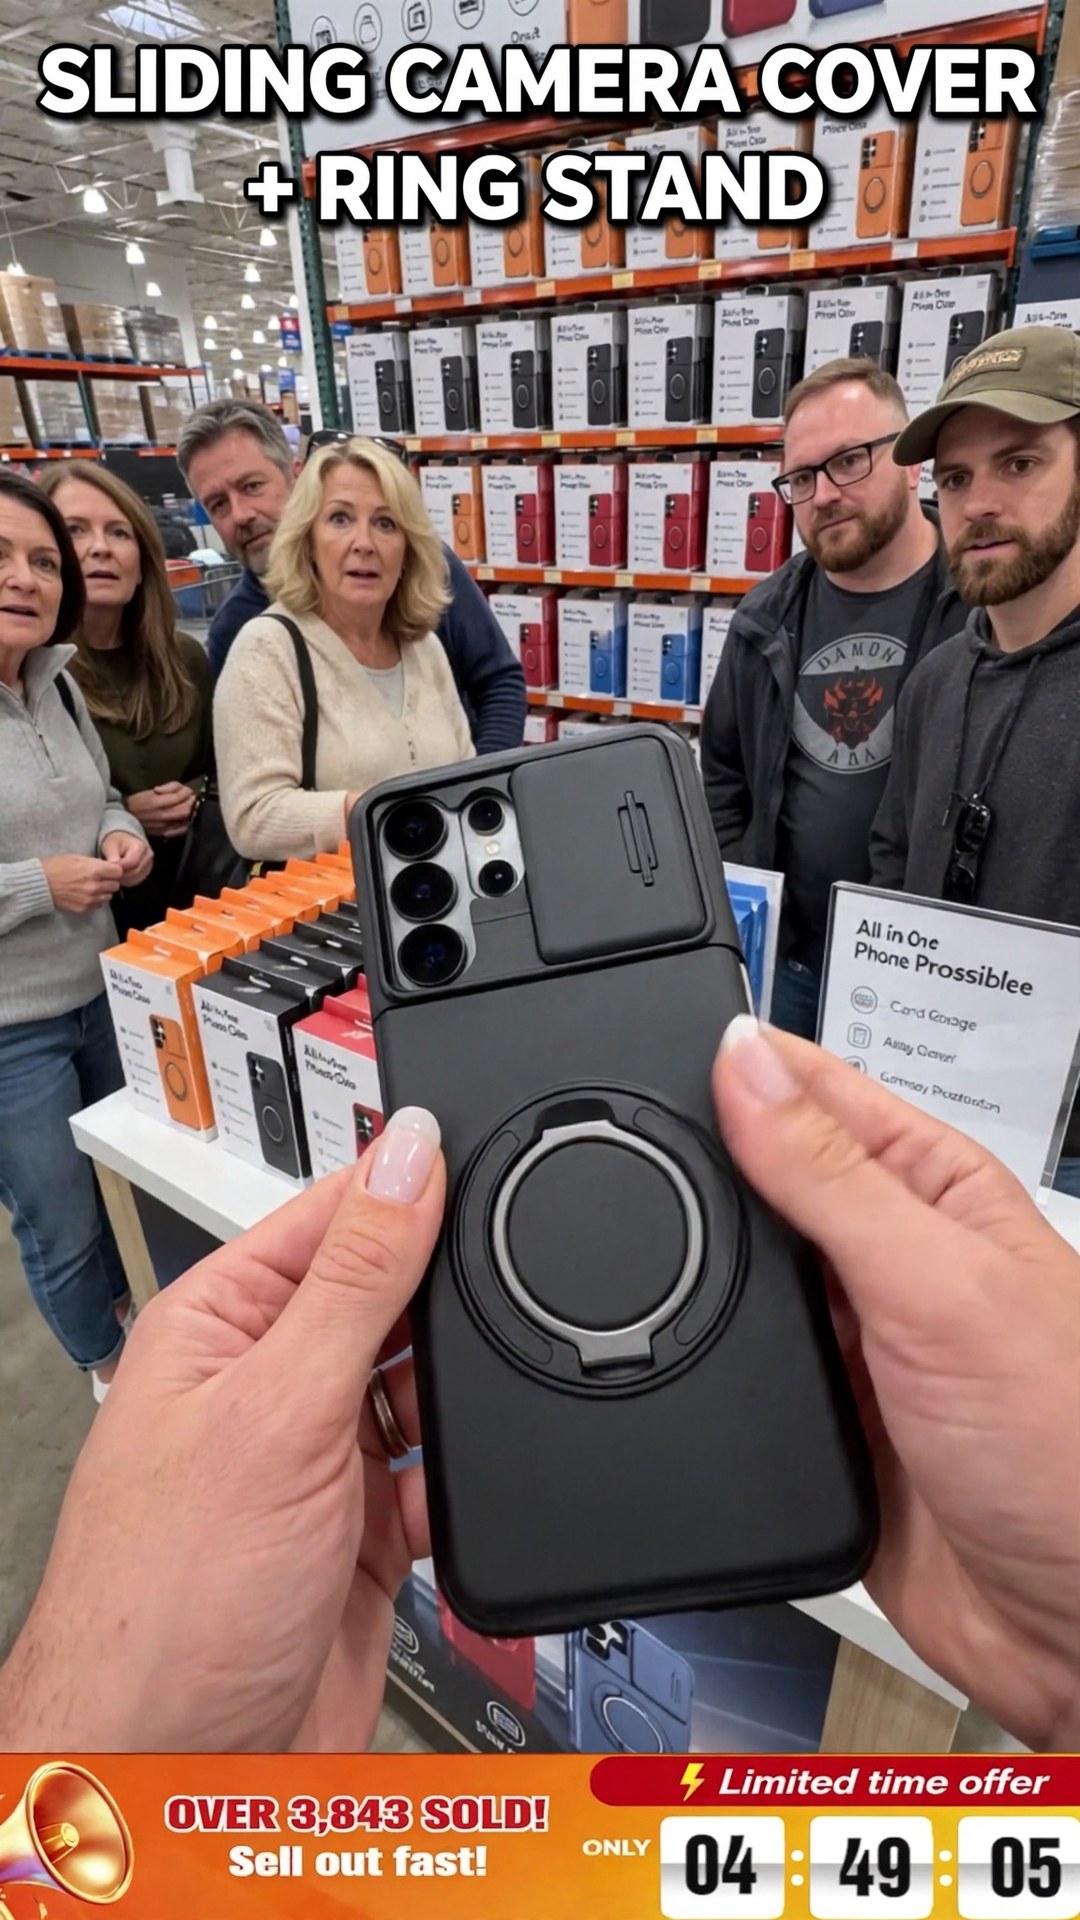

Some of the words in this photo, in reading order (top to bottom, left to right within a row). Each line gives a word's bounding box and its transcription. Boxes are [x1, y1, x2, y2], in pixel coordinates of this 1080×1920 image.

[817, 642, 898, 671] DAMON
[856, 919, 881, 939] All
[886, 923, 904, 944] in
[854, 940, 910, 970] Phone
[915, 953, 1034, 997] Prossiblee
